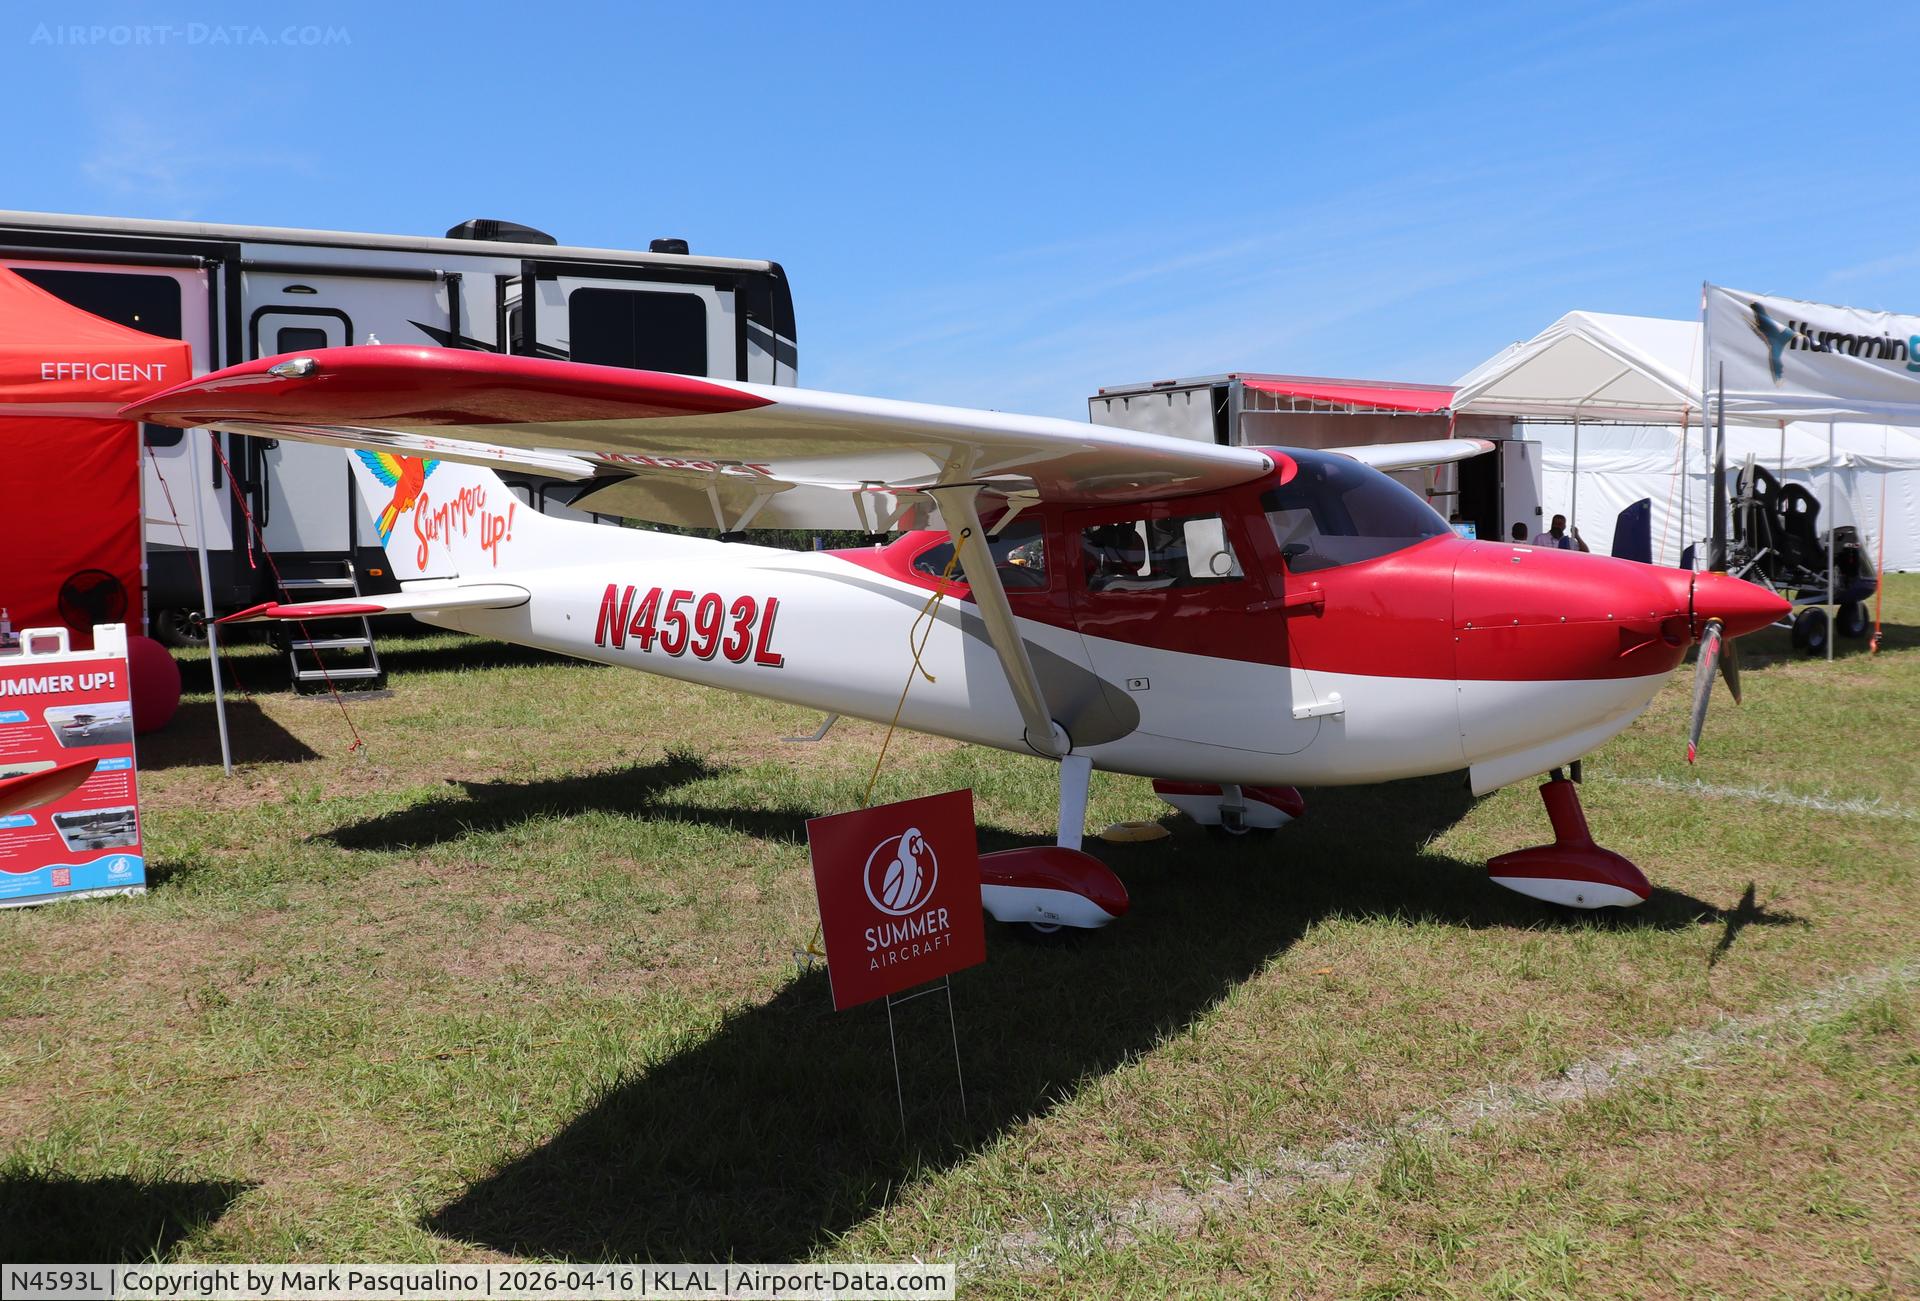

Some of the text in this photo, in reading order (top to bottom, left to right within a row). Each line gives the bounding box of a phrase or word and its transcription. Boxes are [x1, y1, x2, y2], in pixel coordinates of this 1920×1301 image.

[41, 362, 167, 381] EFFICIENT
[414, 484, 487, 572] Summer
[594, 583, 784, 668] N4593L
[79, 671, 116, 691] UP!
[865, 908, 949, 951] SUMMER
[870, 934, 950, 971] AIRCRAFT
